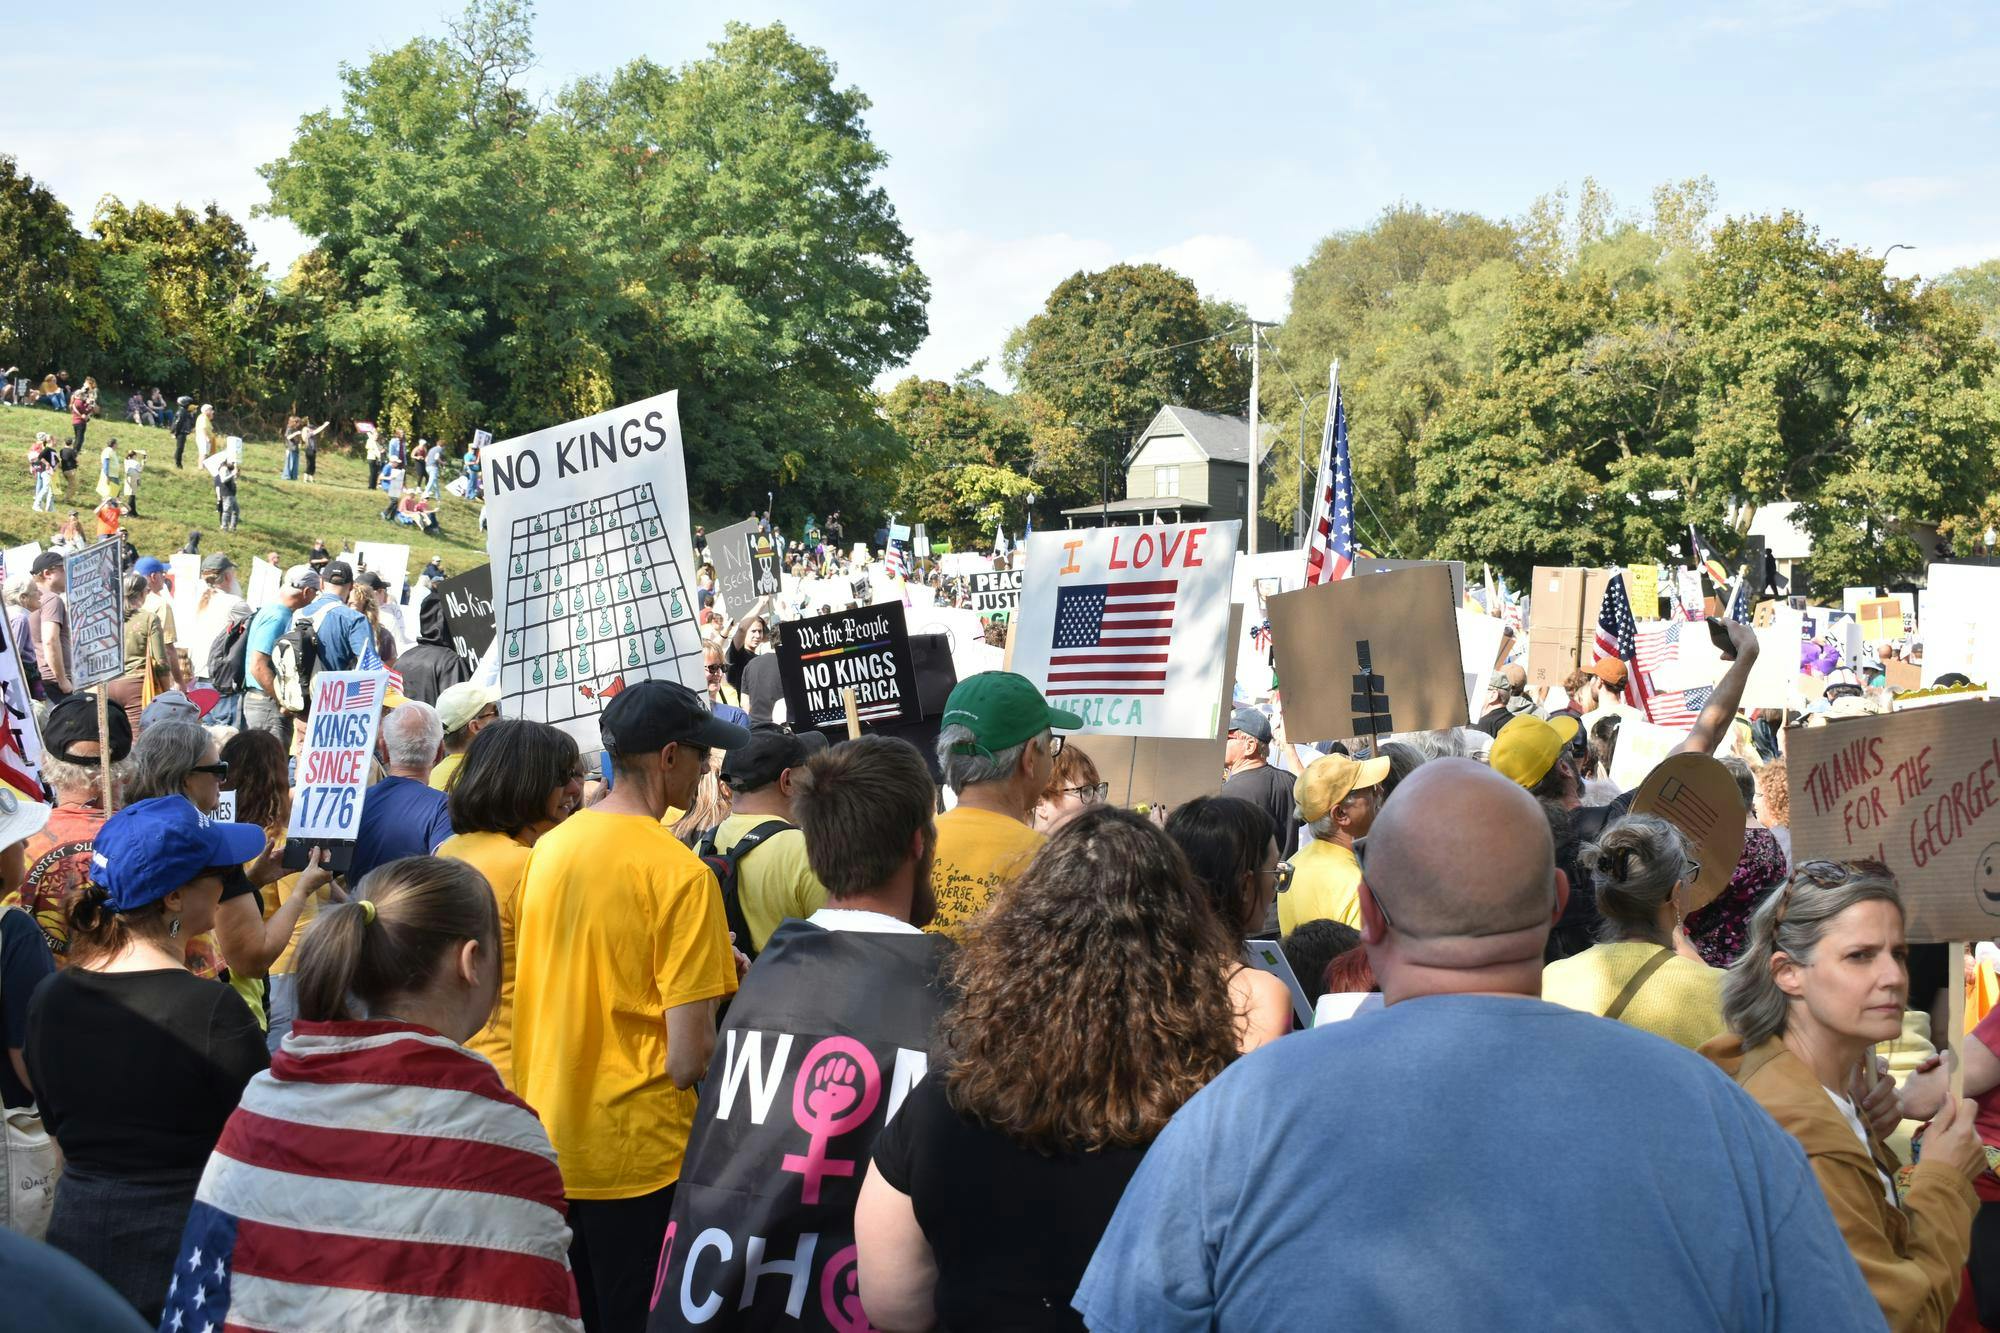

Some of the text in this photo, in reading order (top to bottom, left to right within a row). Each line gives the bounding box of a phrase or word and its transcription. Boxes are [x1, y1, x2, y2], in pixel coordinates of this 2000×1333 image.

[492, 411, 666, 495] NO KINGS
[1059, 527, 1207, 576] I LOVE
[446, 591, 468, 618] No
[797, 614, 889, 649] We the People
[802, 651, 897, 690] NO KINGS
[317, 680, 345, 713] NO
[807, 690, 825, 712] IN
[311, 713, 371, 748] KINGS
[305, 750, 365, 785] SINCE
[1803, 736, 1885, 817] THANKS
[300, 786, 357, 830] 1776
[1843, 745, 1933, 845] FOR THE
